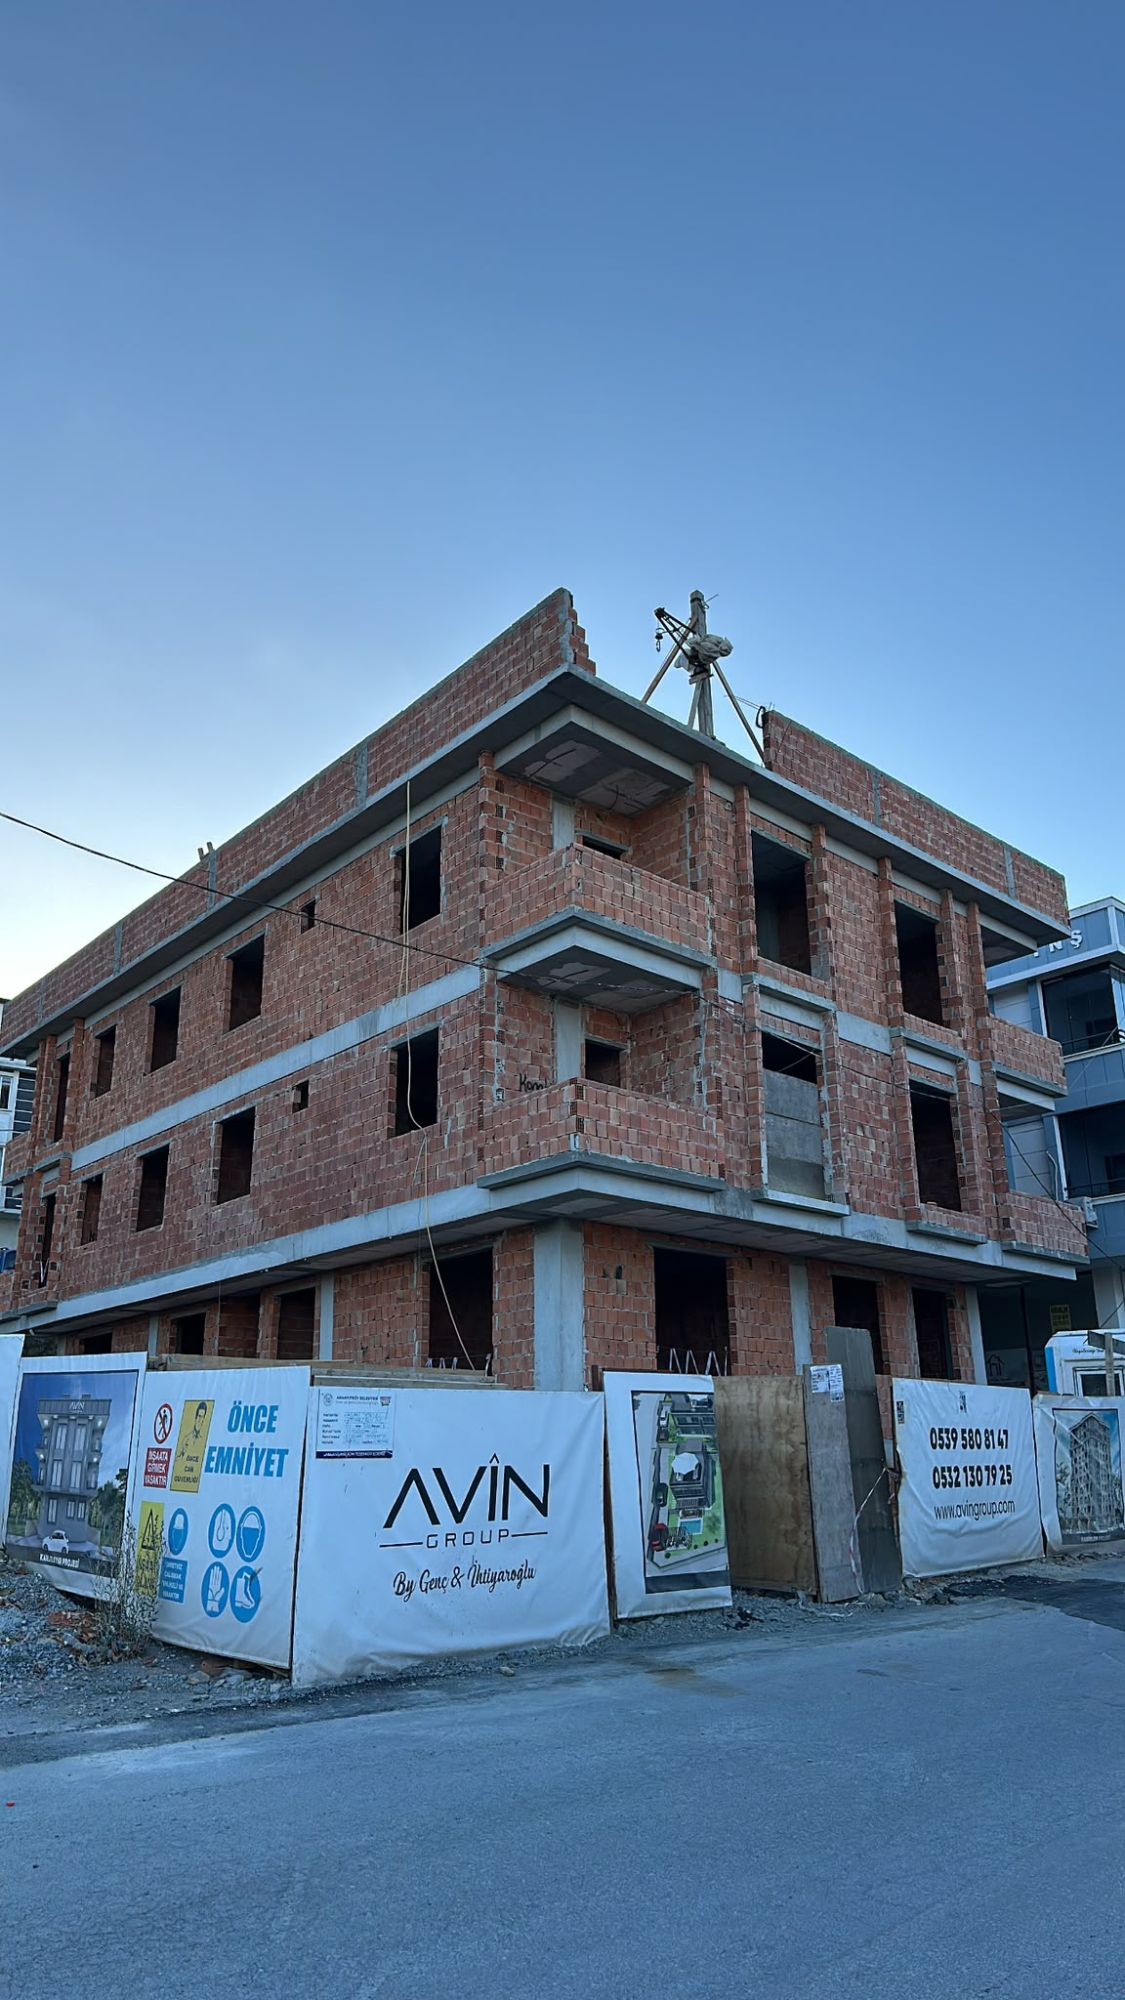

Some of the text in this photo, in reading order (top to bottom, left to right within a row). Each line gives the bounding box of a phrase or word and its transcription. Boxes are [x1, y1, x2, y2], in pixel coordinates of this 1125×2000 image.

[227, 1400, 279, 1433] ÖNCE
[929, 1427, 1009, 1450] 0539 580 81 47
[204, 1442, 289, 1477] EMNİYET
[932, 1464, 1012, 1490] 0532 130 79 25
[933, 1499, 1016, 1521] www.avingroup.com
[426, 1528, 510, 1549] GROUP
[393, 1559, 537, 1603] By Genç & İhtiyaroğlu
